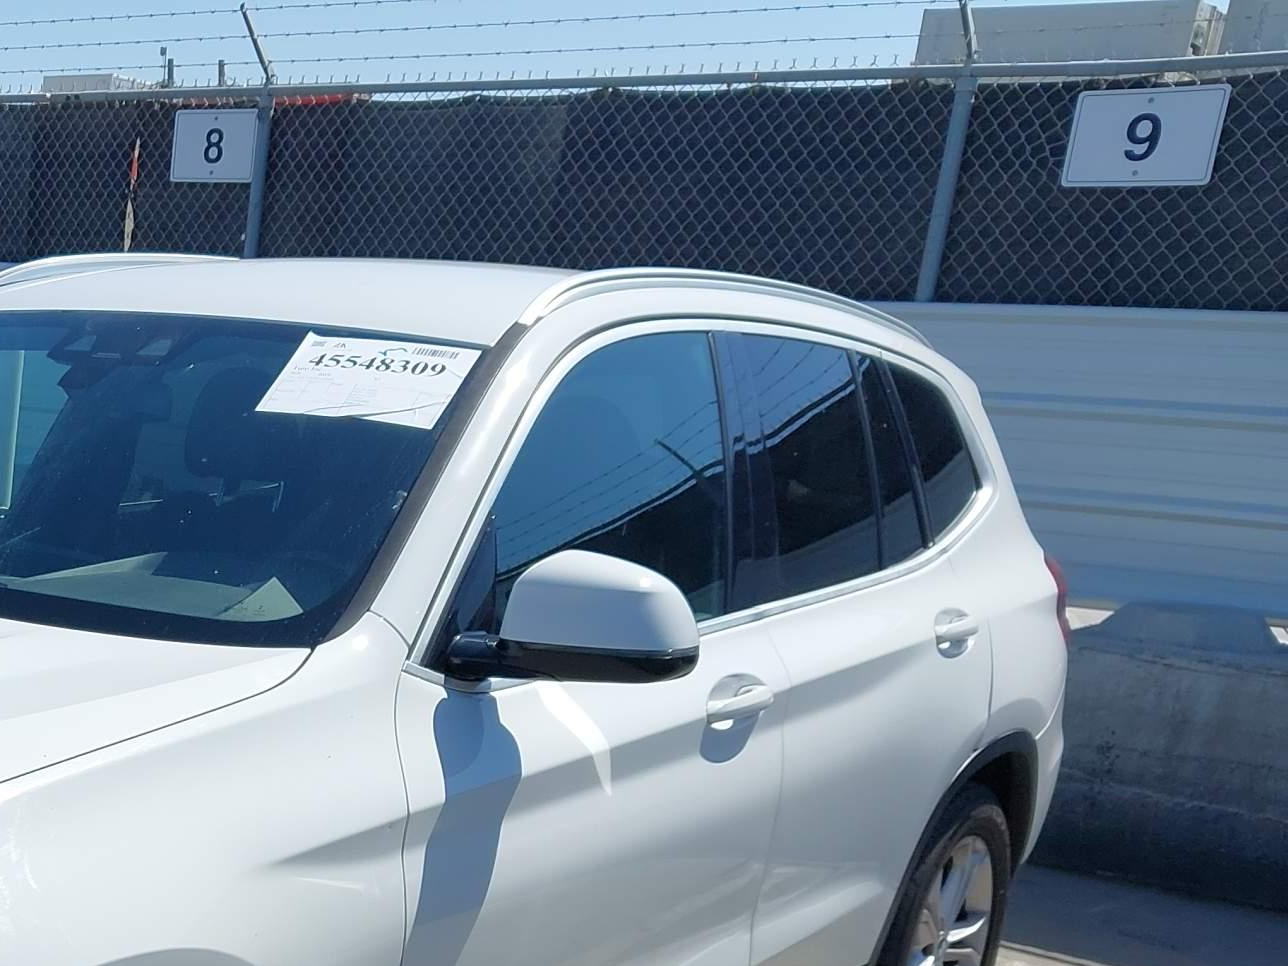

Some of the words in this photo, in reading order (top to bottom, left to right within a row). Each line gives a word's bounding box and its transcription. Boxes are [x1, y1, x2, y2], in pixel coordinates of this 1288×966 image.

[204, 128, 223, 164] 8
[1124, 113, 1162, 161] 9
[309, 353, 447, 376] 45548309
